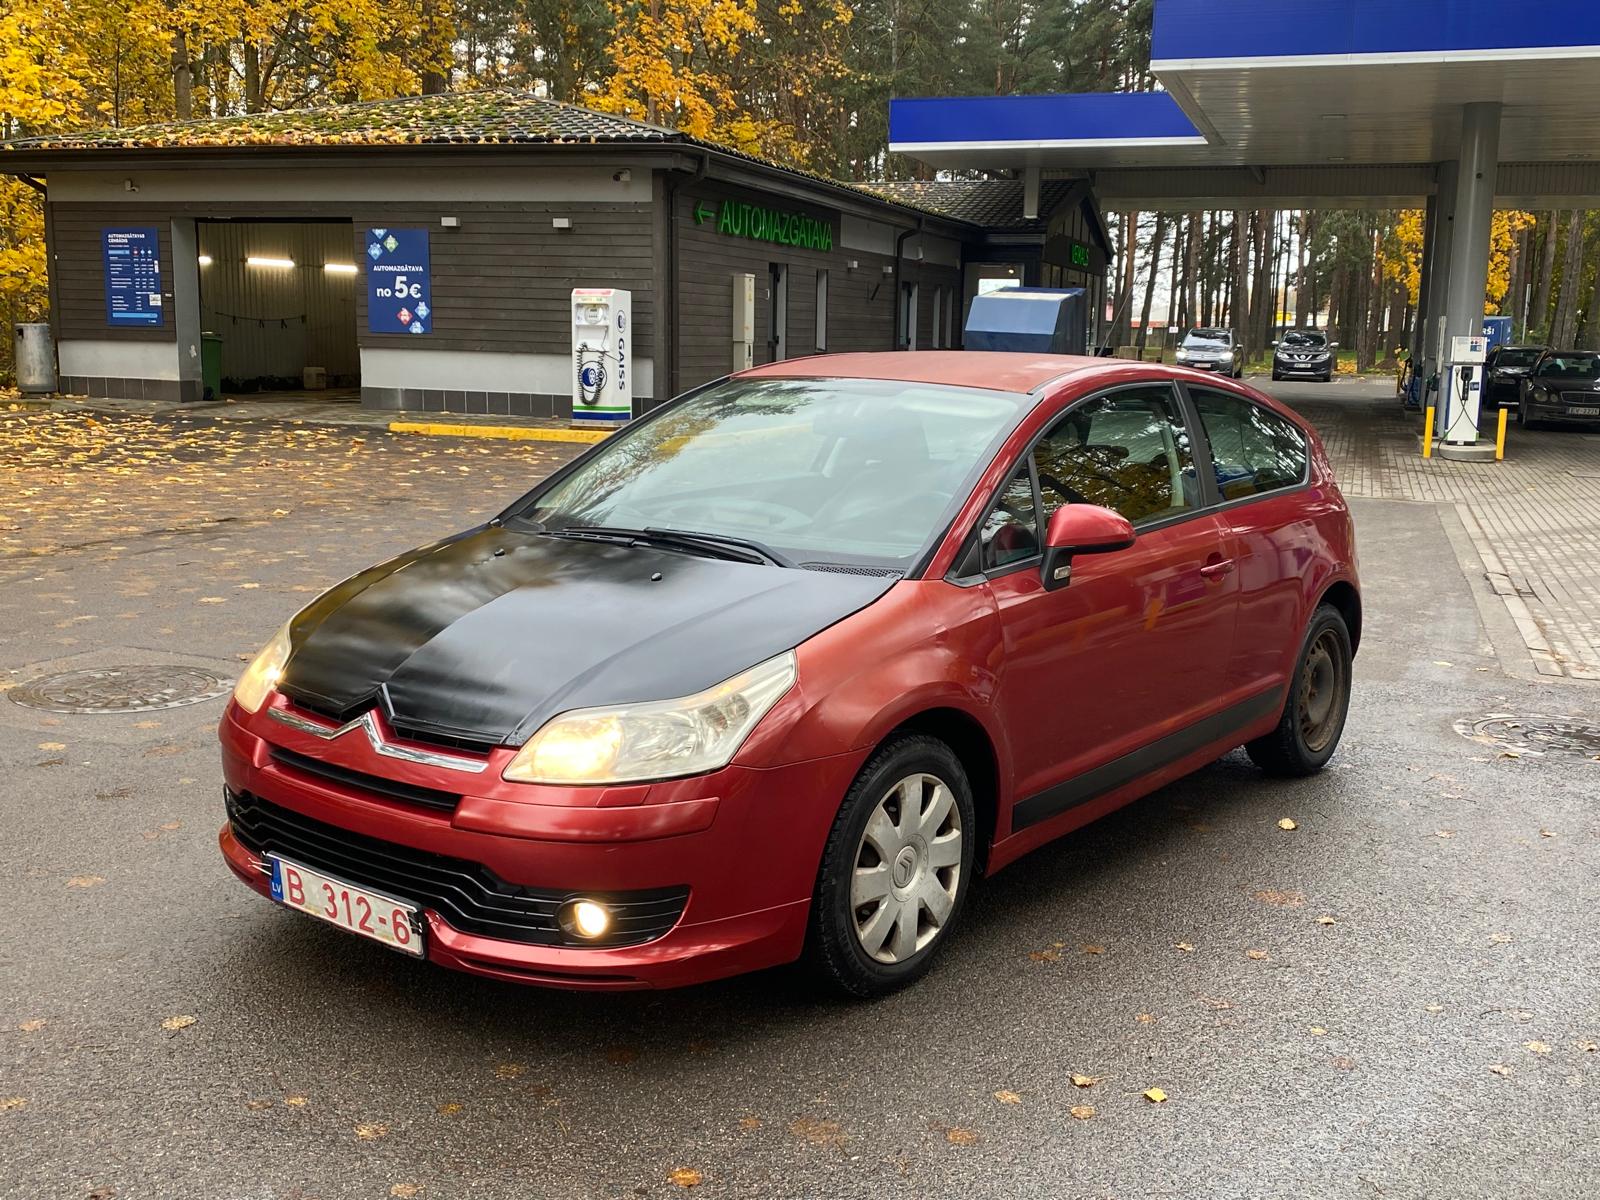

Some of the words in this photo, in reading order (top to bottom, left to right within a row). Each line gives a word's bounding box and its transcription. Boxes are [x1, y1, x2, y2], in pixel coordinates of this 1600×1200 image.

[720, 199, 833, 251] AUTOMAZGĀTAVA
[373, 263, 423, 272] AUTOMAZGĀTAVA
[376, 287, 392, 297] no
[618, 337, 626, 391] GAISS
[271, 881, 282, 893] LV
[286, 867, 305, 906] B
[322, 882, 410, 945] 312-6
